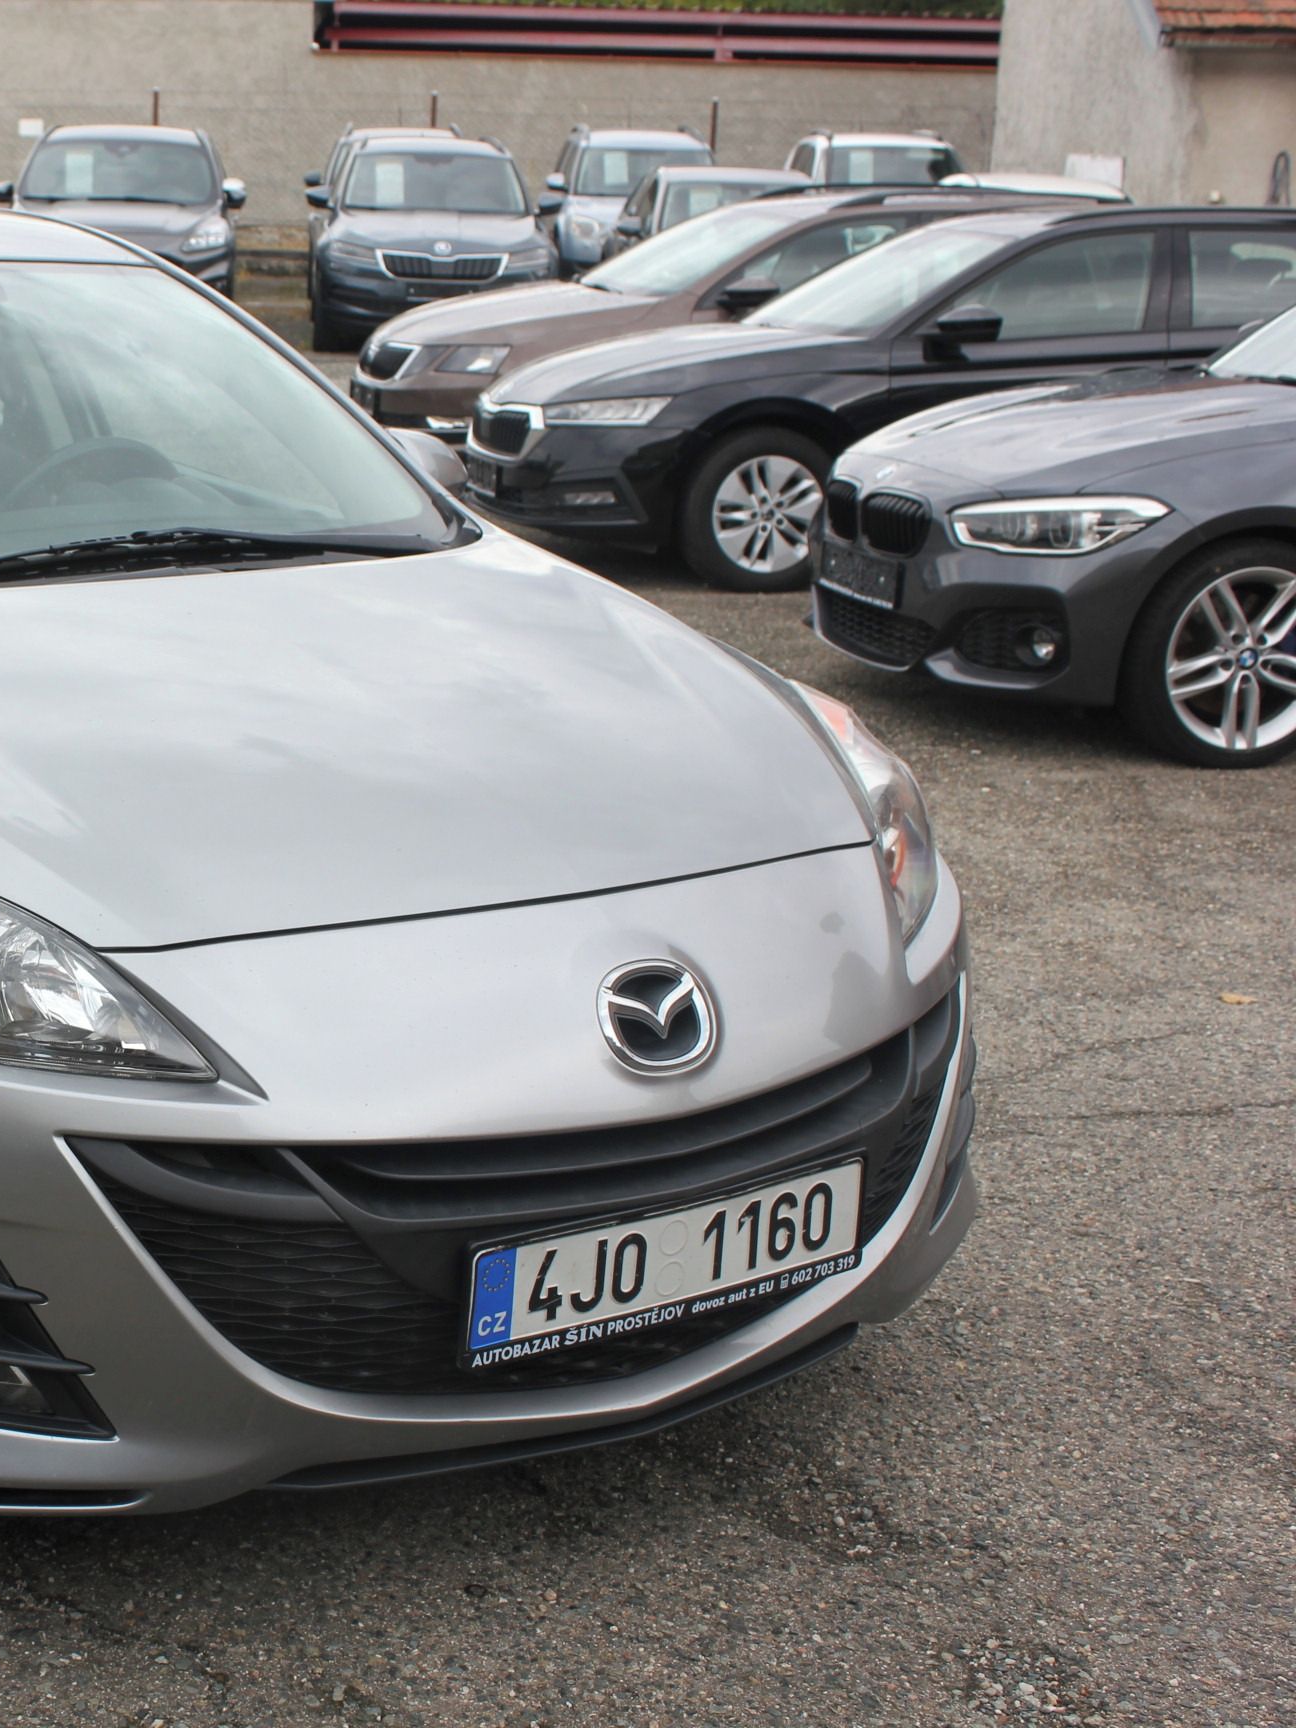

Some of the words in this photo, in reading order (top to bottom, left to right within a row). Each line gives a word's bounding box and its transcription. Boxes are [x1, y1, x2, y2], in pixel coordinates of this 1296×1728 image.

[527, 1231, 648, 1321] 4J0
[702, 1182, 834, 1281] 1160
[471, 1335, 560, 1368] AUTOBAZAR
[564, 1323, 604, 1346] ŠÍN
[607, 1304, 685, 1336] PROSTĚJOV
[692, 1296, 725, 1314] dovoz
[728, 1288, 748, 1303] aut
[749, 1287, 757, 1297] z
[758, 1280, 775, 1295] EU
[791, 1269, 812, 1285] 602
[814, 1261, 835, 1279] 703
[836, 1255, 855, 1272] 319
[478, 1311, 507, 1337] CZ
